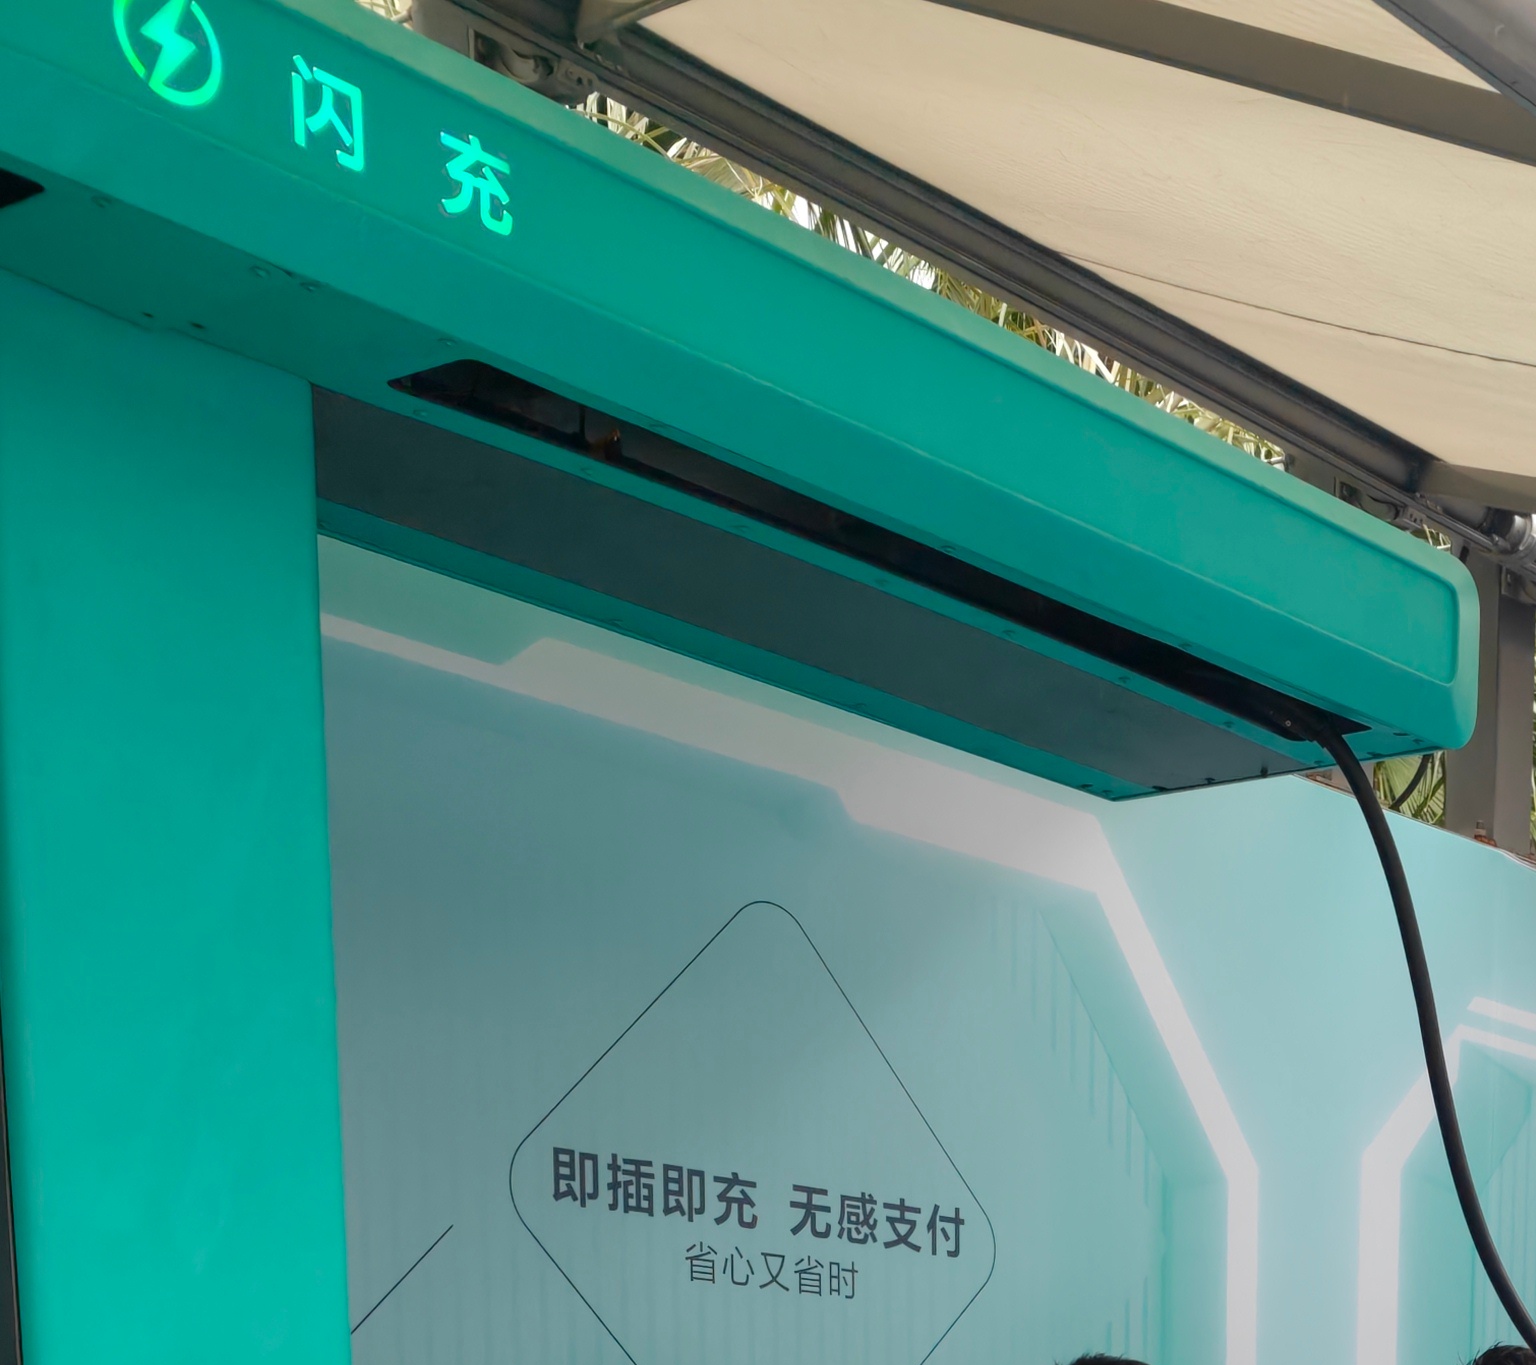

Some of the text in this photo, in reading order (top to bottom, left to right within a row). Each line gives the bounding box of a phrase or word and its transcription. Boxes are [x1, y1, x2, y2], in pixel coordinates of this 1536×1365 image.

[291, 54, 513, 237] 闪充
[552, 1146, 965, 1258] 即插即充 无感支付
[685, 1241, 859, 1300] 省心又省时
